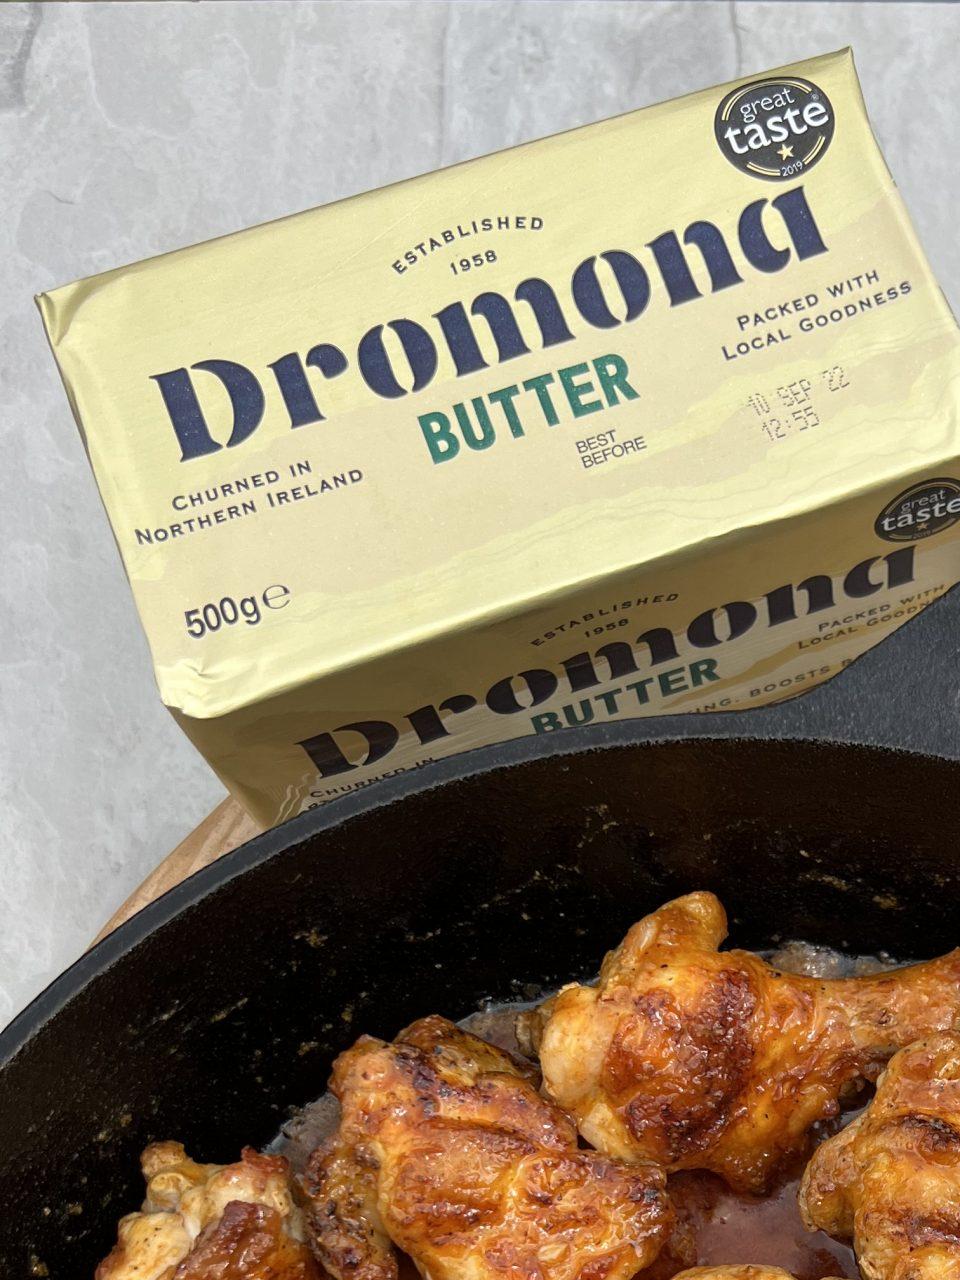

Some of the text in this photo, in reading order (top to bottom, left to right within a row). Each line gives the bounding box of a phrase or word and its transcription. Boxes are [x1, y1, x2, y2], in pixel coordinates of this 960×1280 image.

[724, 102, 829, 154] taste
[740, 87, 795, 123] great
[781, 161, 803, 176] 2019
[391, 216, 543, 275] ESTABLISHED
[450, 249, 498, 275] 1958
[148, 185, 829, 462] Dromona
[721, 280, 912, 360] LOCAL GOODNESS
[737, 269, 880, 331] PACKED WITH
[417, 352, 640, 464] BUTTER
[777, 379, 811, 407] SEP
[822, 366, 850, 391] 22
[575, 429, 617, 453] BEST
[762, 406, 819, 441] 12:55
[581, 435, 647, 468] BEFORE
[135, 468, 363, 545] NORTHERN IRELAND
[171, 460, 312, 511] CHURNED IN
[901, 489, 945, 514] great
[530, 593, 679, 646] ESTABLISHED
[584, 618, 629, 638] 1958
[798, 600, 930, 650] LOCAL GOODN
[818, 584, 945, 632] PACKED WITH
[293, 545, 916, 778] Dromona
[749, 665, 831, 698] BOOSTS
[530, 658, 721, 735] BUTTER
[310, 768, 406, 798] CHURNED
